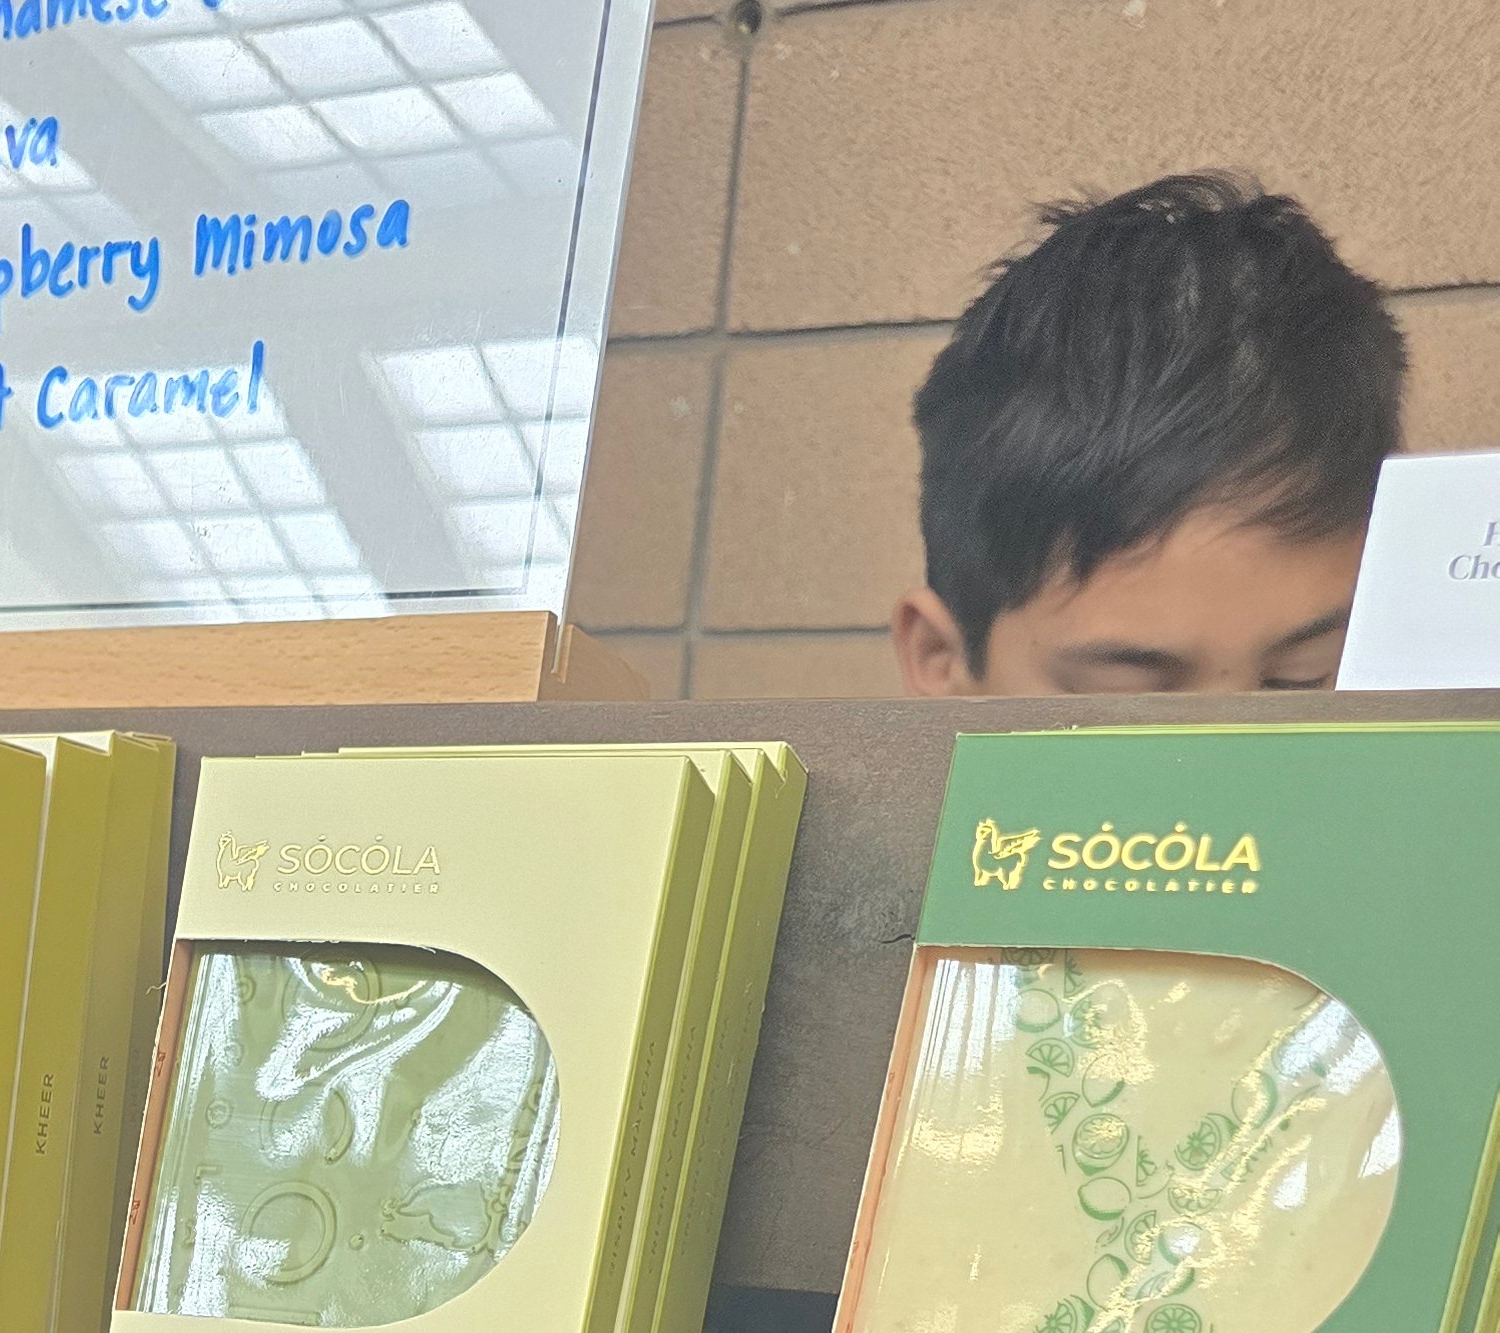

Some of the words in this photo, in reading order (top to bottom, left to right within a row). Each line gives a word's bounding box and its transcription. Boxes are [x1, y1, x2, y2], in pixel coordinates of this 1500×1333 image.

[194, 200, 411, 276] Mimosa
[38, 341, 266, 430] Caramel
[273, 880, 441, 896] CHOCOLATIER
[1042, 877, 1260, 895] CHOCOLATIER
[34, 1073, 54, 1155] KHEER
[92, 1056, 110, 1135] KHEER
